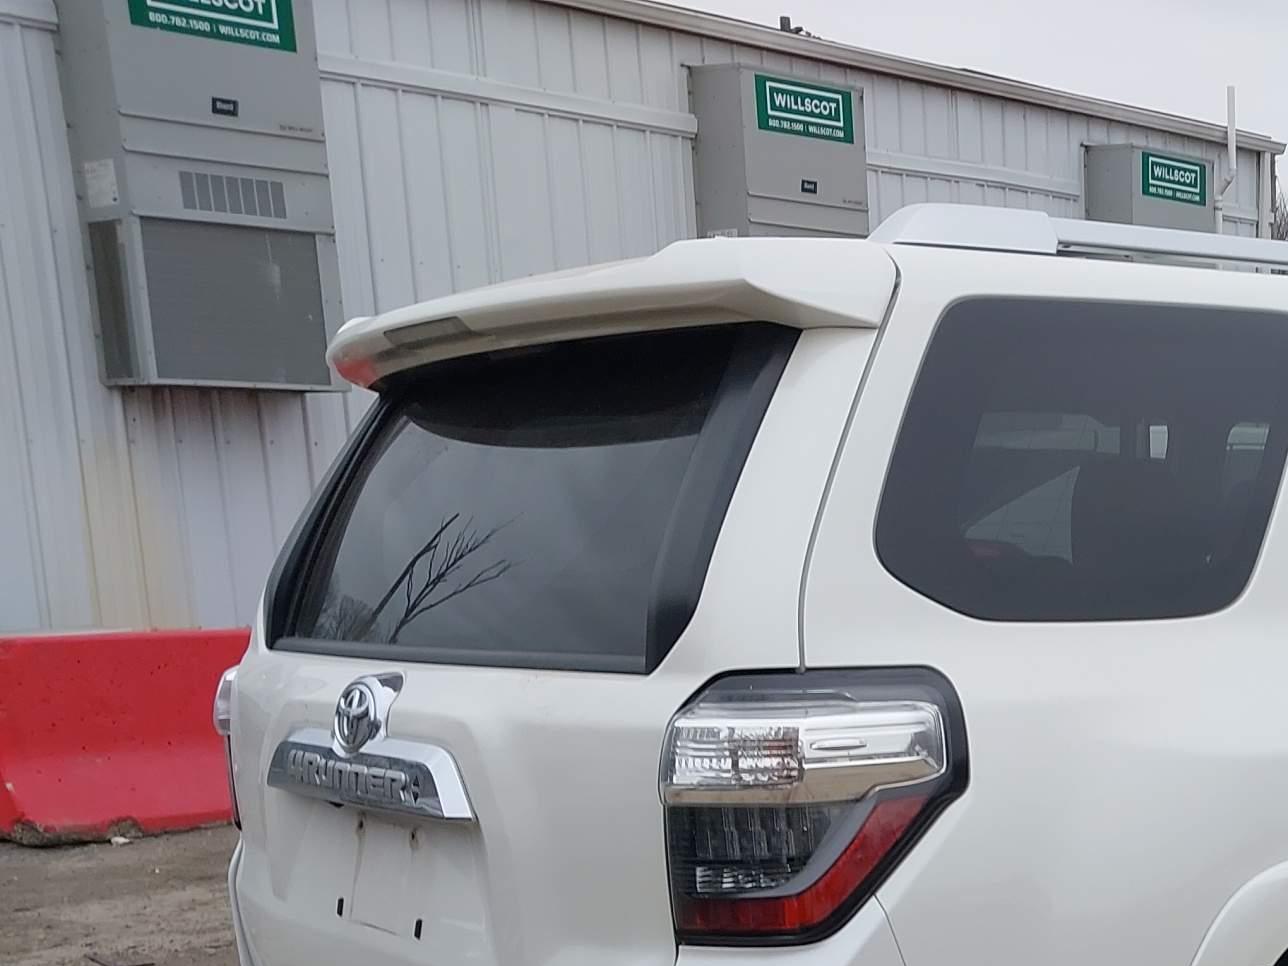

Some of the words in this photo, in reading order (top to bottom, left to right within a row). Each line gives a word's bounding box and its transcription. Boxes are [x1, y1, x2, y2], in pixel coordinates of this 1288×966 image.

[218, 24, 280, 44] WILLSCOT.COM
[773, 92, 836, 117] WILLSCOT
[1153, 165, 1196, 184] WILLSCOT
